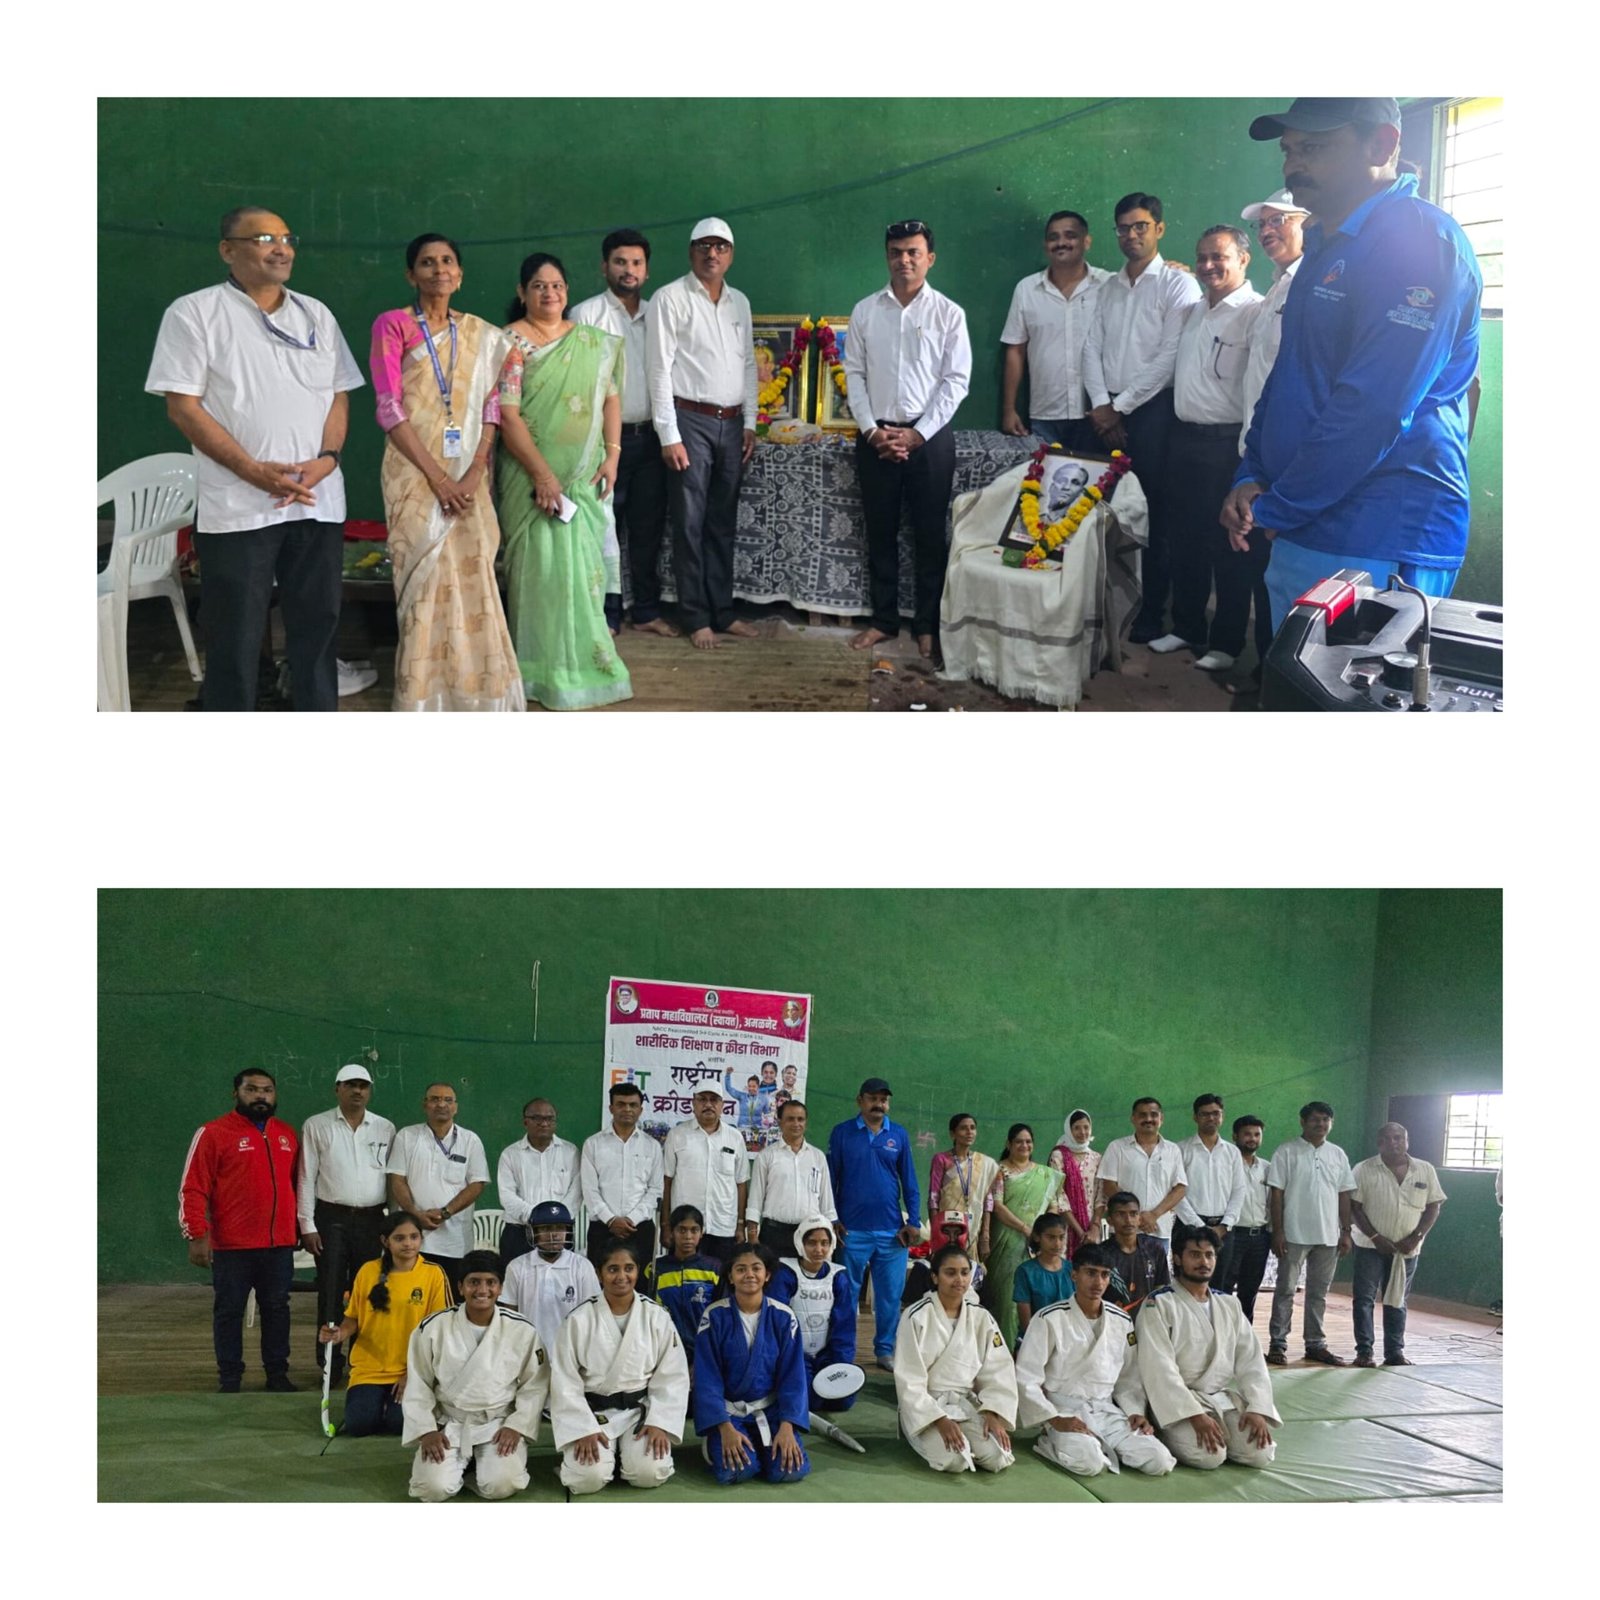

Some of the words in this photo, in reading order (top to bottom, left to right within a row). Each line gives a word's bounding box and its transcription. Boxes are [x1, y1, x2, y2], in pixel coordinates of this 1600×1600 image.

[640, 1008, 660, 1020] प्रताप
[661, 1008, 709, 1024] महाविद्यालय
[744, 1016, 778, 1030] अमळनेर
[636, 1033, 679, 1049] शारीरिक
[681, 1035, 714, 1051] शिक्षण
[716, 1041, 723, 1052] व
[725, 1039, 748, 1055] क्रीडा
[750, 1041, 780, 1057] विभाग
[653, 1090, 694, 1115] क्रीड
